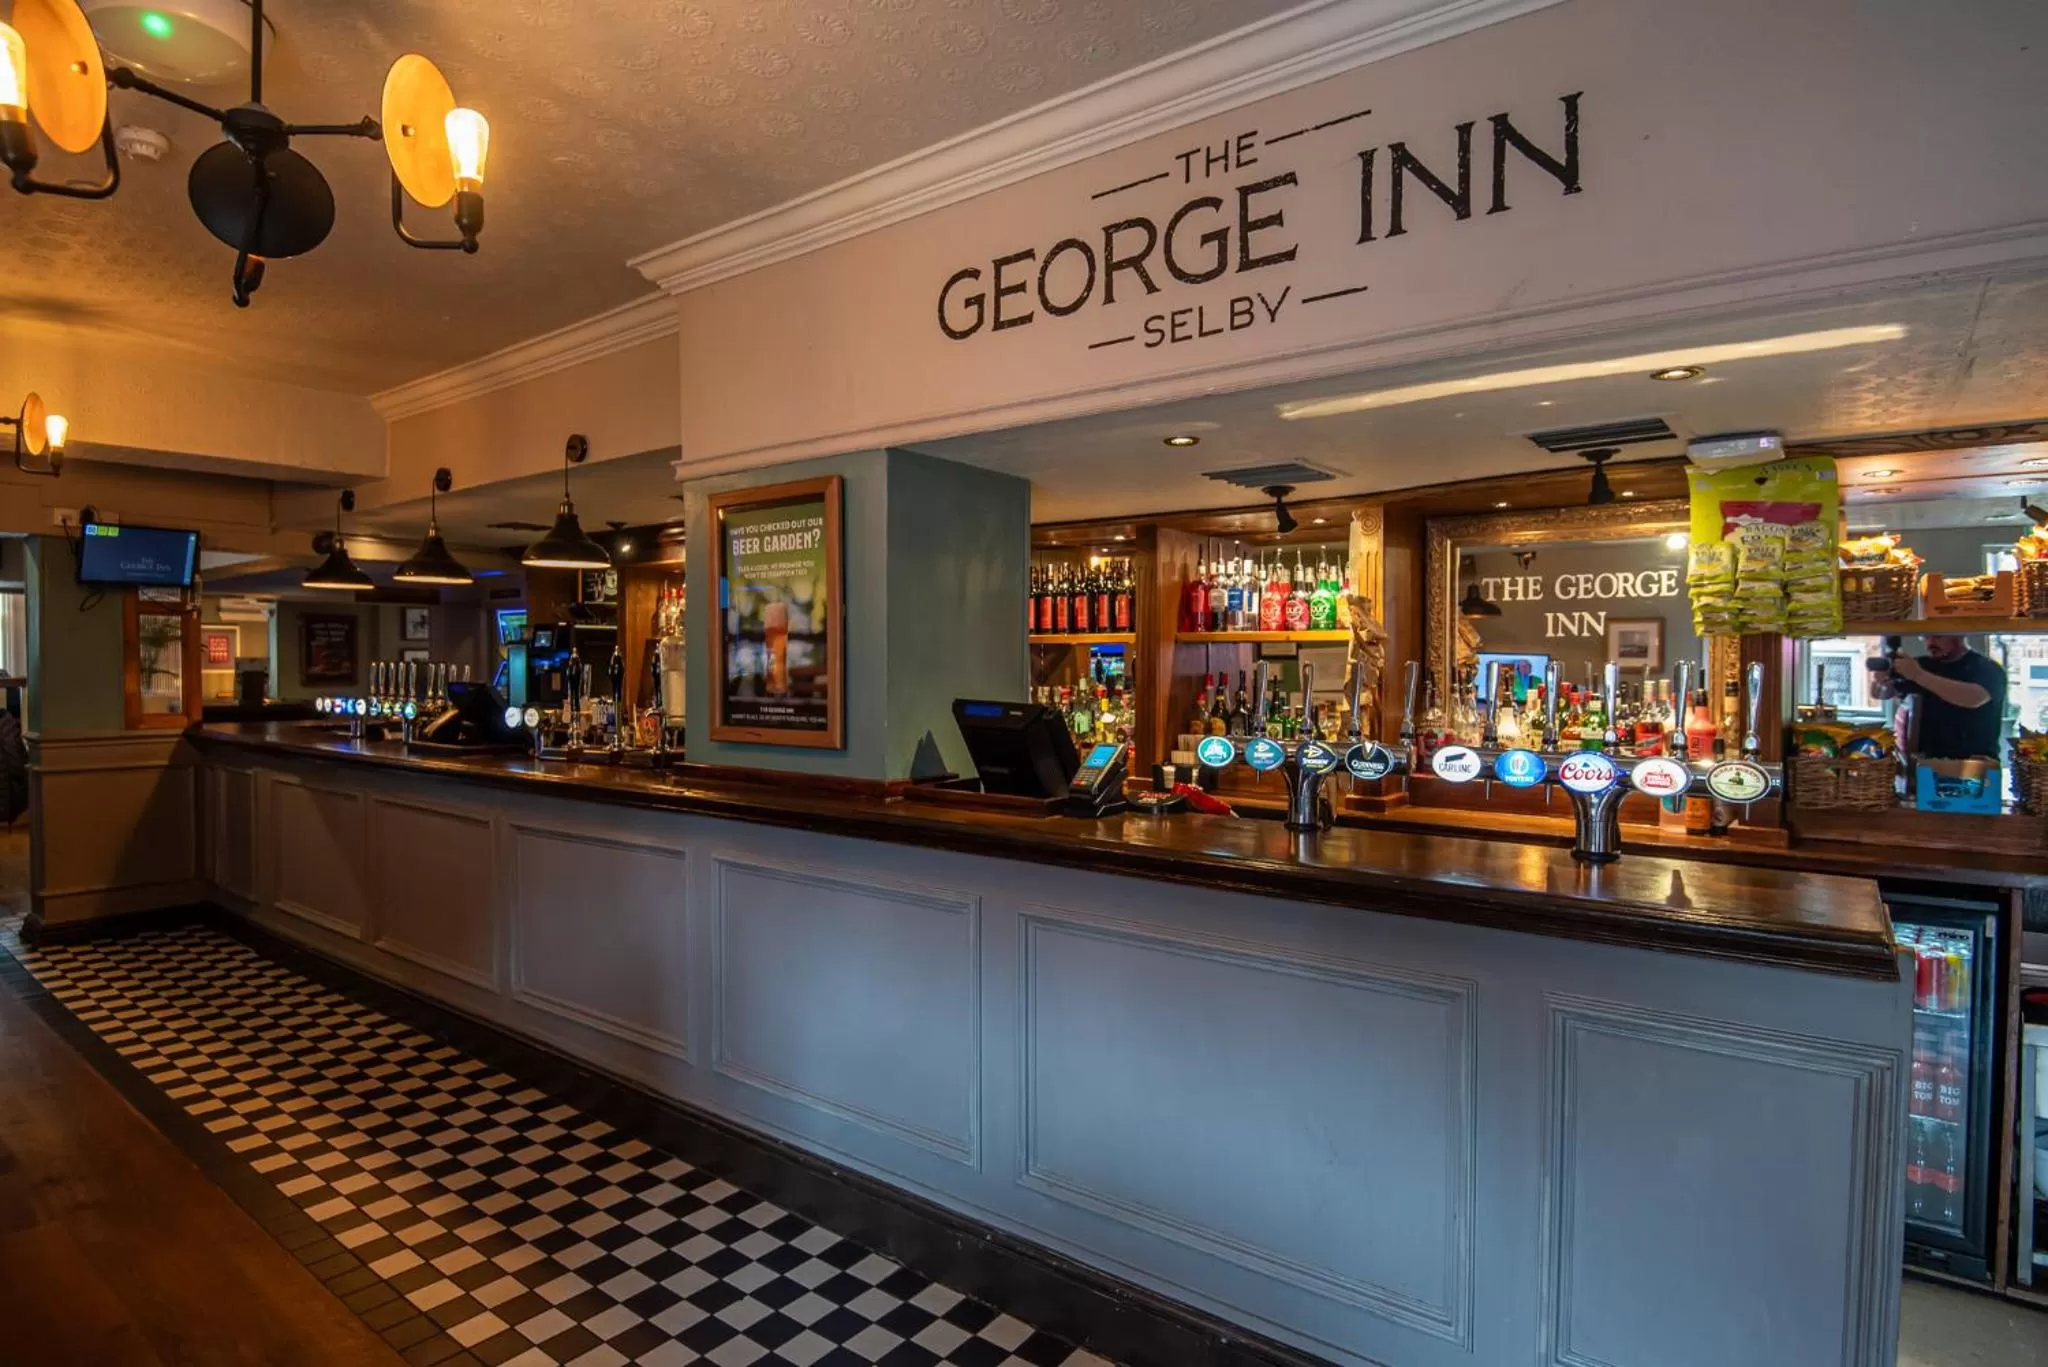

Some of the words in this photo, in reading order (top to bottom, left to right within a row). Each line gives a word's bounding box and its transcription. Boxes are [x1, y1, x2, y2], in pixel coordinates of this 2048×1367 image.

[1175, 130, 1259, 184] THE
[938, 171, 1299, 341] GEORGE
[1356, 91, 1584, 245] INN
[1143, 286, 1291, 349] SELBY
[745, 525, 759, 534] YOU
[760, 522, 790, 533] CHECKED
[791, 519, 806, 529] OUT
[807, 517, 824, 526] OUR
[733, 538, 760, 556] BEER
[764, 528, 821, 552] GARDEN?
[1481, 576, 1544, 601] THE
[1554, 570, 1680, 599] GEORGE
[1544, 611, 1608, 637] INN
[1438, 761, 1473, 774] CARLING
[1560, 763, 1614, 780] Coors
[1914, 1080, 1933, 1090] BIG
[1940, 1084, 1960, 1096] BIG
[1940, 1095, 1960, 1106] TOM
